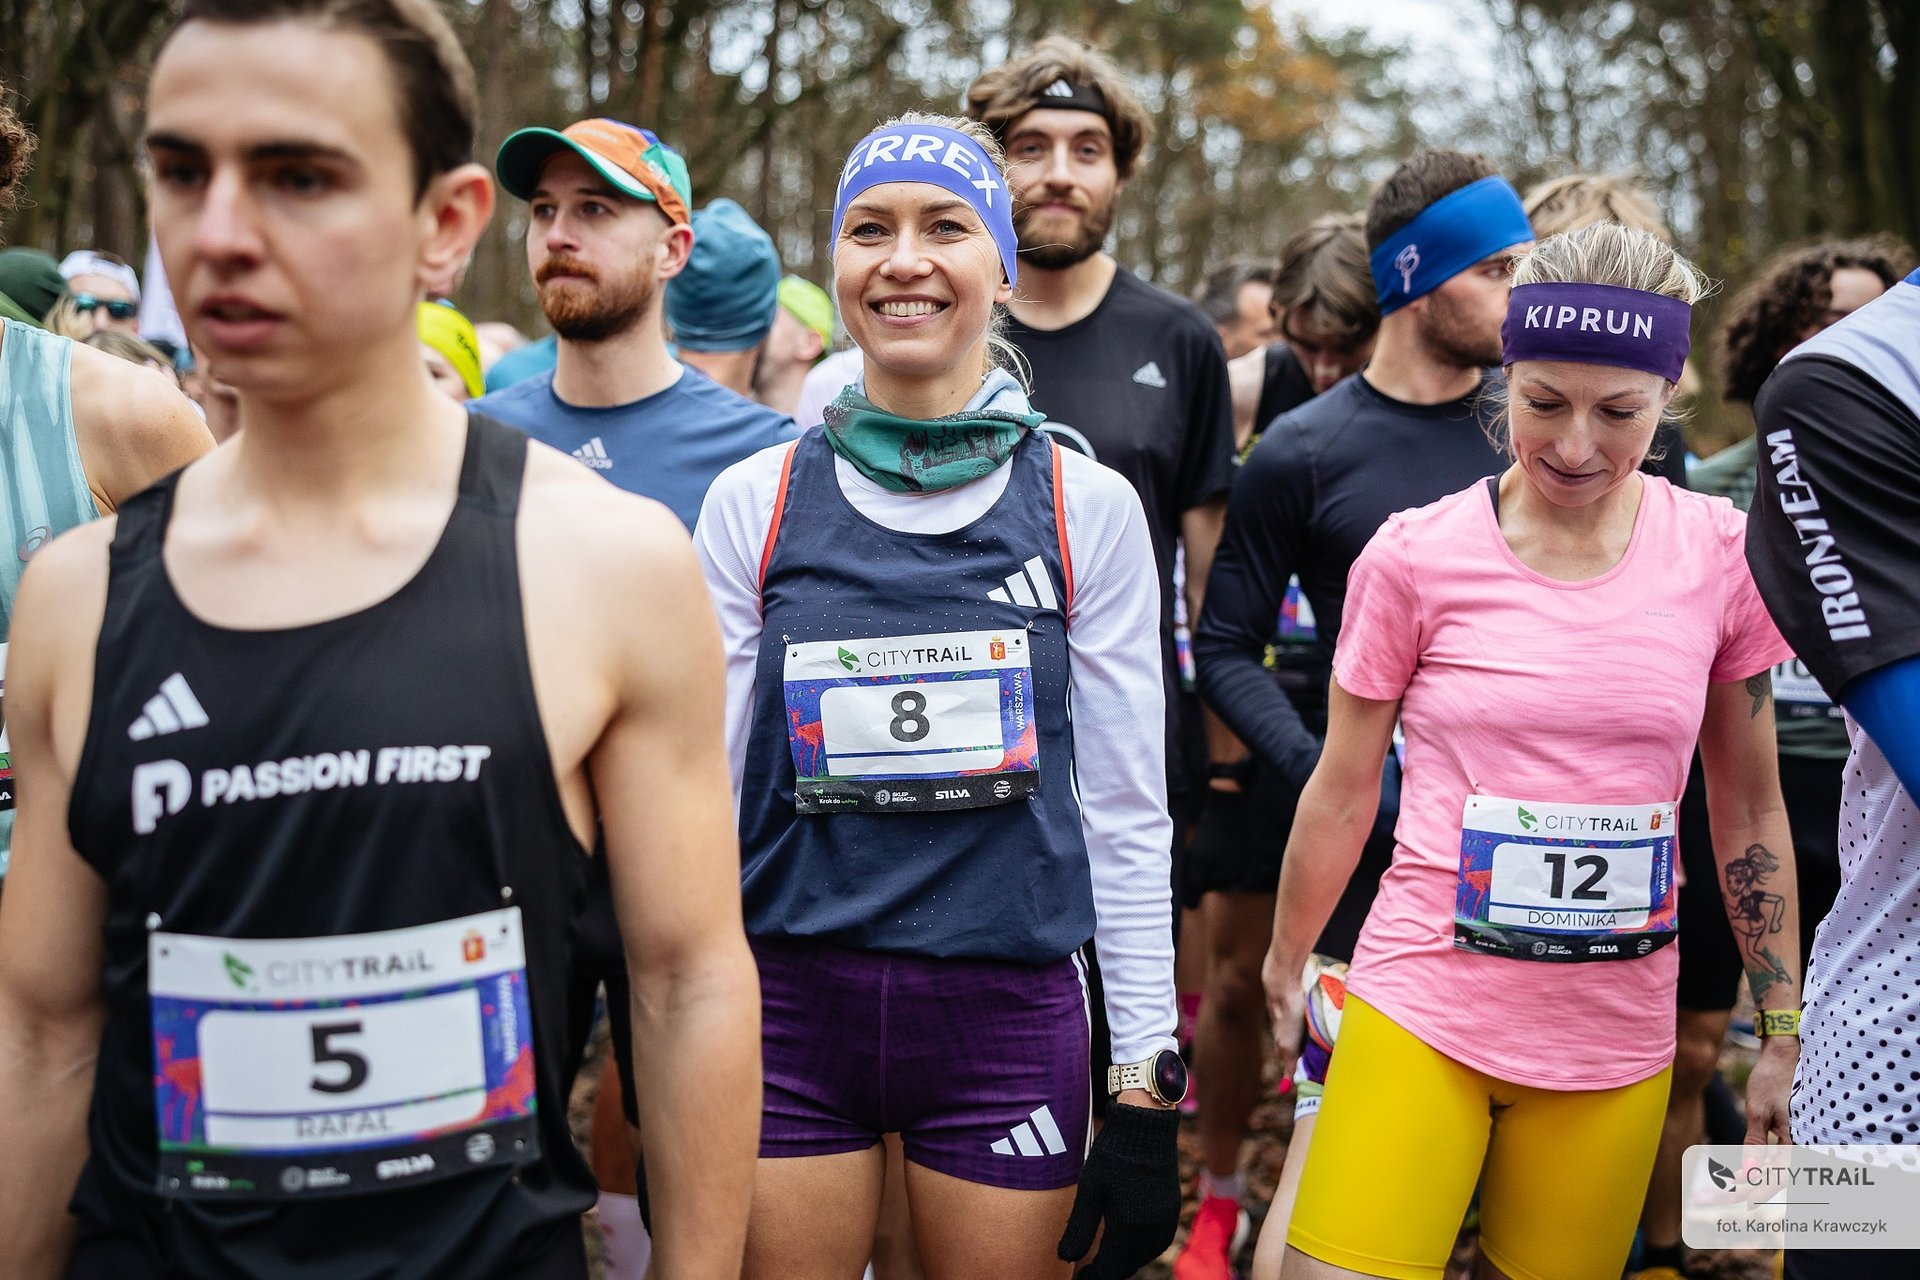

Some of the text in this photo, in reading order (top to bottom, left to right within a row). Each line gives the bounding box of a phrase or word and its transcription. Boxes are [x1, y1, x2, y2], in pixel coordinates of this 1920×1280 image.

[1524, 305, 1653, 340] KIPRUN
[1766, 428, 1872, 642] IRONTEAM
[889, 690, 931, 743] 8
[1013, 671, 1026, 731] WARSZAWA
[202, 744, 491, 807] PASSION FIRST
[935, 788, 971, 800] SILVA
[1543, 852, 1610, 901] 12
[1659, 839, 1670, 895] WARSZAWA
[1528, 910, 1617, 927] DOMINIKA
[1589, 944, 1619, 954] SILVA
[309, 1020, 371, 1096] 5
